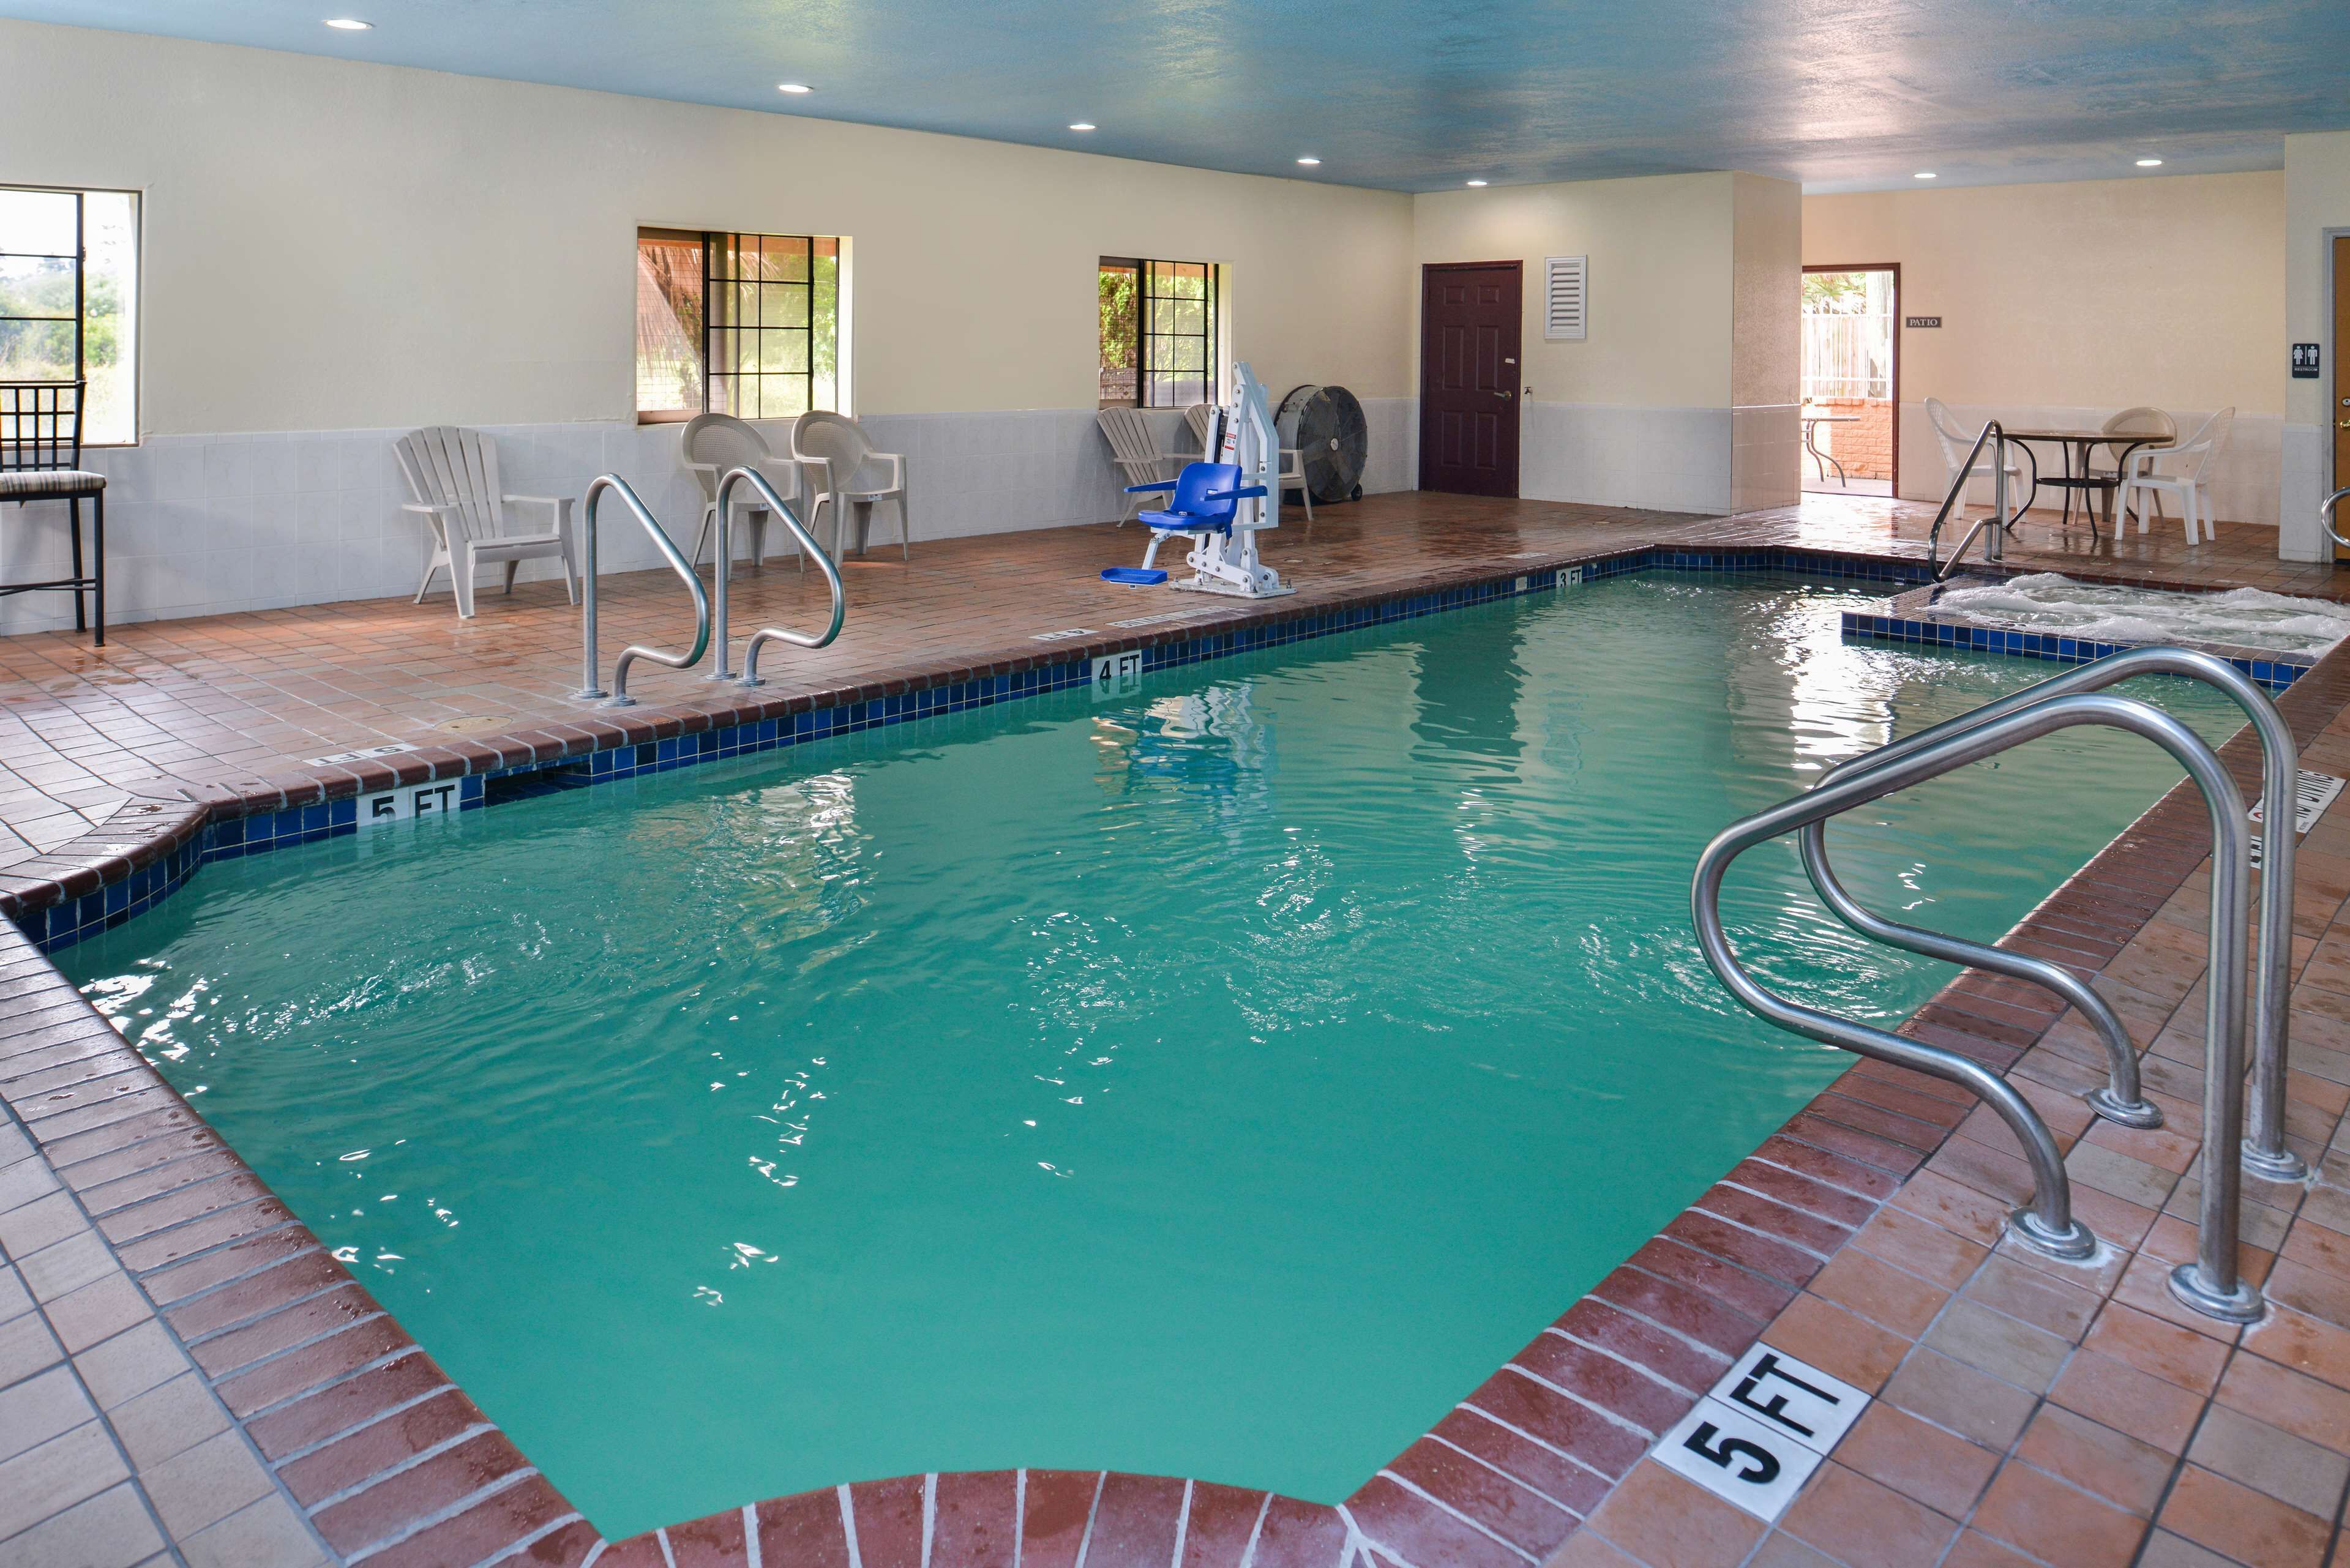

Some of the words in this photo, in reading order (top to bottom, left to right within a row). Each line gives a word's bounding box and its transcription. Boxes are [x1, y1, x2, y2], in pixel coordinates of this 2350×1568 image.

[1560, 572, 1566, 586] 3
[1570, 569, 1581, 584] FT
[1113, 614, 1182, 627] DIVING
[1099, 660, 1112, 679] 4
[1119, 654, 1140, 676] FT
[318, 753, 362, 765] FT
[374, 746, 404, 755] 5
[372, 795, 396, 824] 5
[414, 784, 456, 818] FT
[1729, 1353, 1841, 1438] FT
[1683, 1421, 1781, 1485] 5
